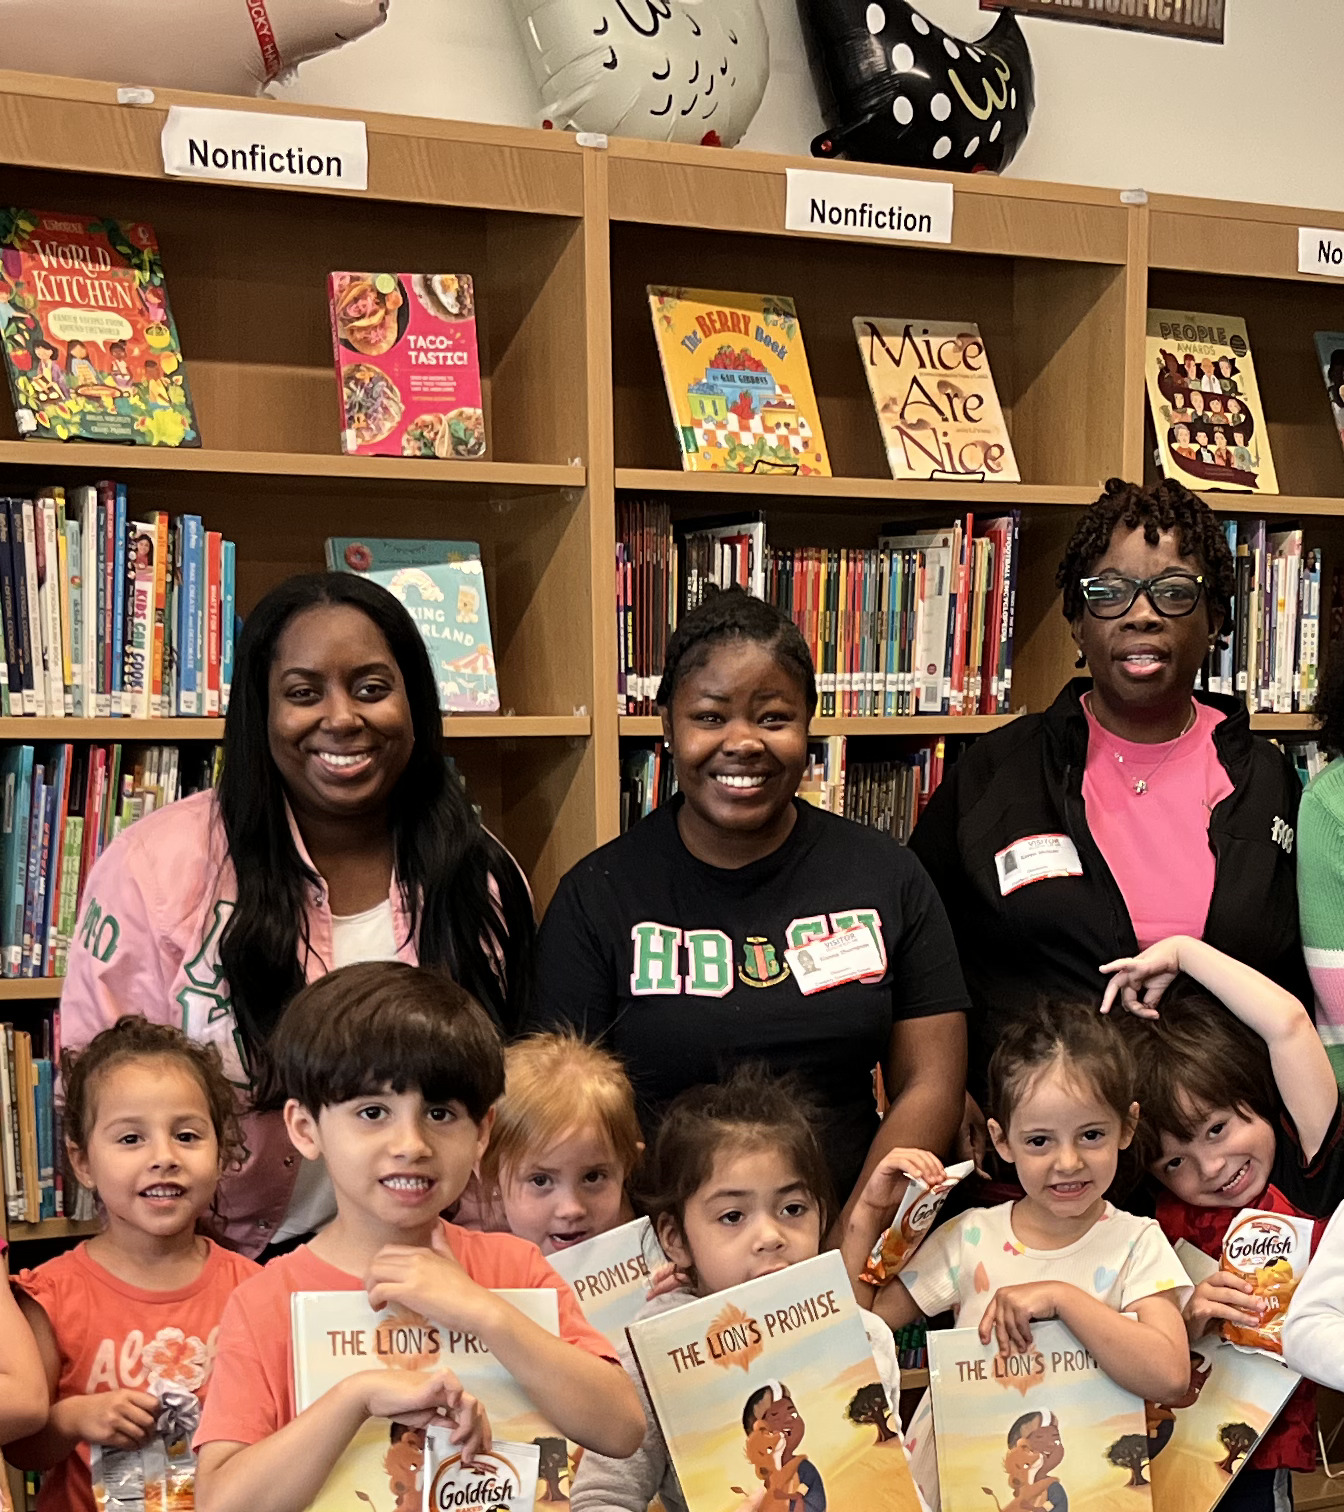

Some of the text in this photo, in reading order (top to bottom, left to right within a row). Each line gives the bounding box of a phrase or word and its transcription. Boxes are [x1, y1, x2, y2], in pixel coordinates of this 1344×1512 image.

[187, 138, 343, 178] Nonfiction
[809, 198, 932, 233] Nonfiction
[32, 240, 111, 278] WORLD
[31, 270, 134, 308] KITCHEN
[695, 310, 751, 339] BERRY
[1159, 322, 1227, 346] PEOPLE
[407, 335, 453, 349] TACO-
[864, 322, 982, 371] Mice
[1177, 343, 1215, 355] AWARDS
[408, 352, 468, 365] TASTIC!
[899, 375, 984, 423] Are
[891, 425, 1005, 473] Nice
[135, 589, 148, 620] KIDS
[134, 622, 146, 650] CAN
[824, 933, 855, 947] VISITOR
[1229, 1236, 1292, 1258] Goldfish
[574, 1253, 650, 1301] PROMISE
[327, 1330, 367, 1356] THE
[377, 1329, 440, 1355] LION'S
[668, 1290, 840, 1374] THE LION'S PROMISE
[956, 1360, 987, 1383] THE
[440, 1478, 513, 1509] Goldfish
